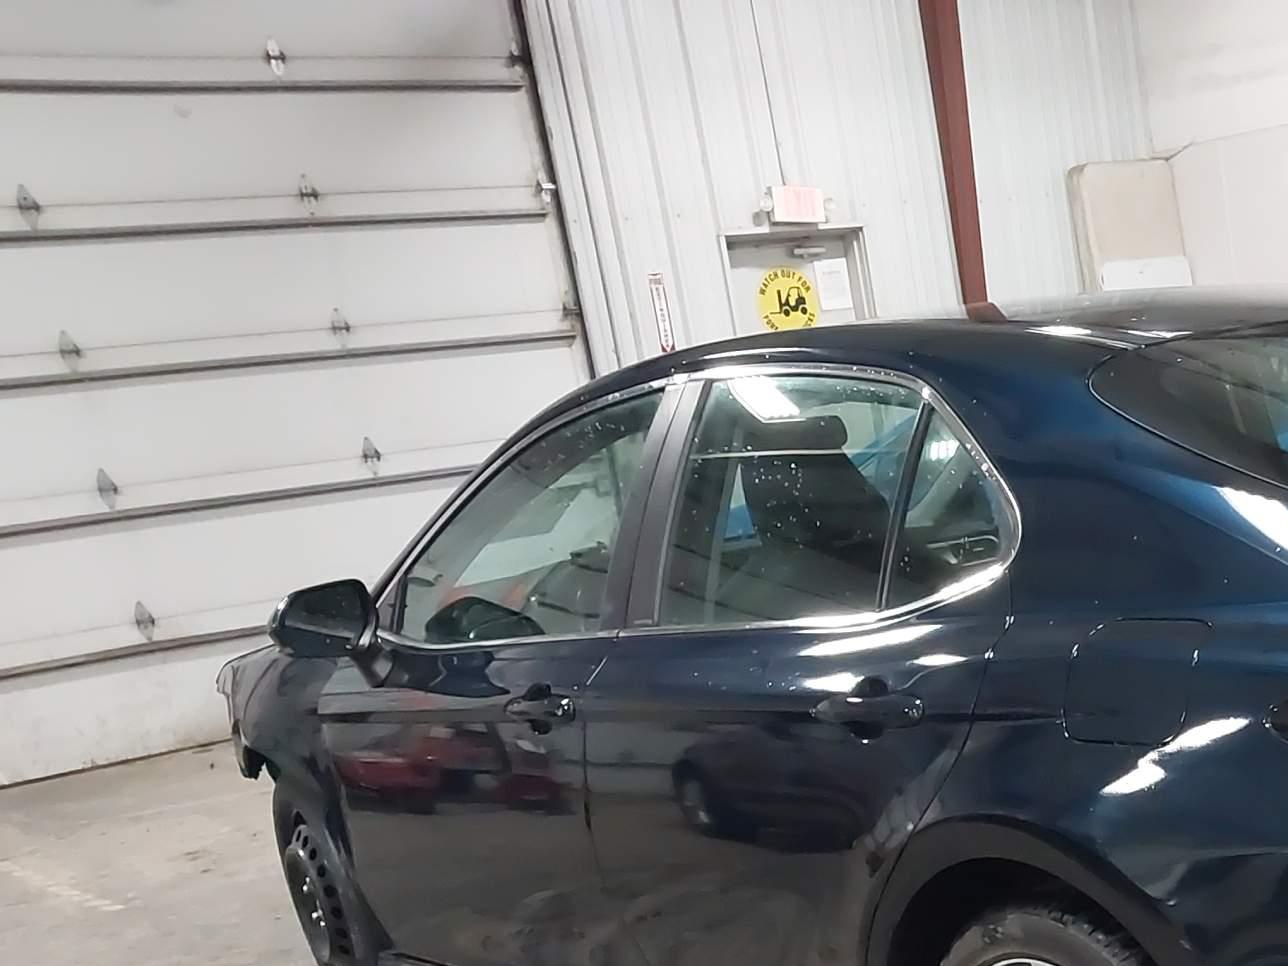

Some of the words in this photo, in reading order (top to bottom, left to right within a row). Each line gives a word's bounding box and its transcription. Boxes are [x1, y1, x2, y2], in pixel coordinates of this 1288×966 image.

[759, 271, 779, 296] WATCH
[780, 269, 796, 280] OUT
[797, 276, 811, 293] FOR
